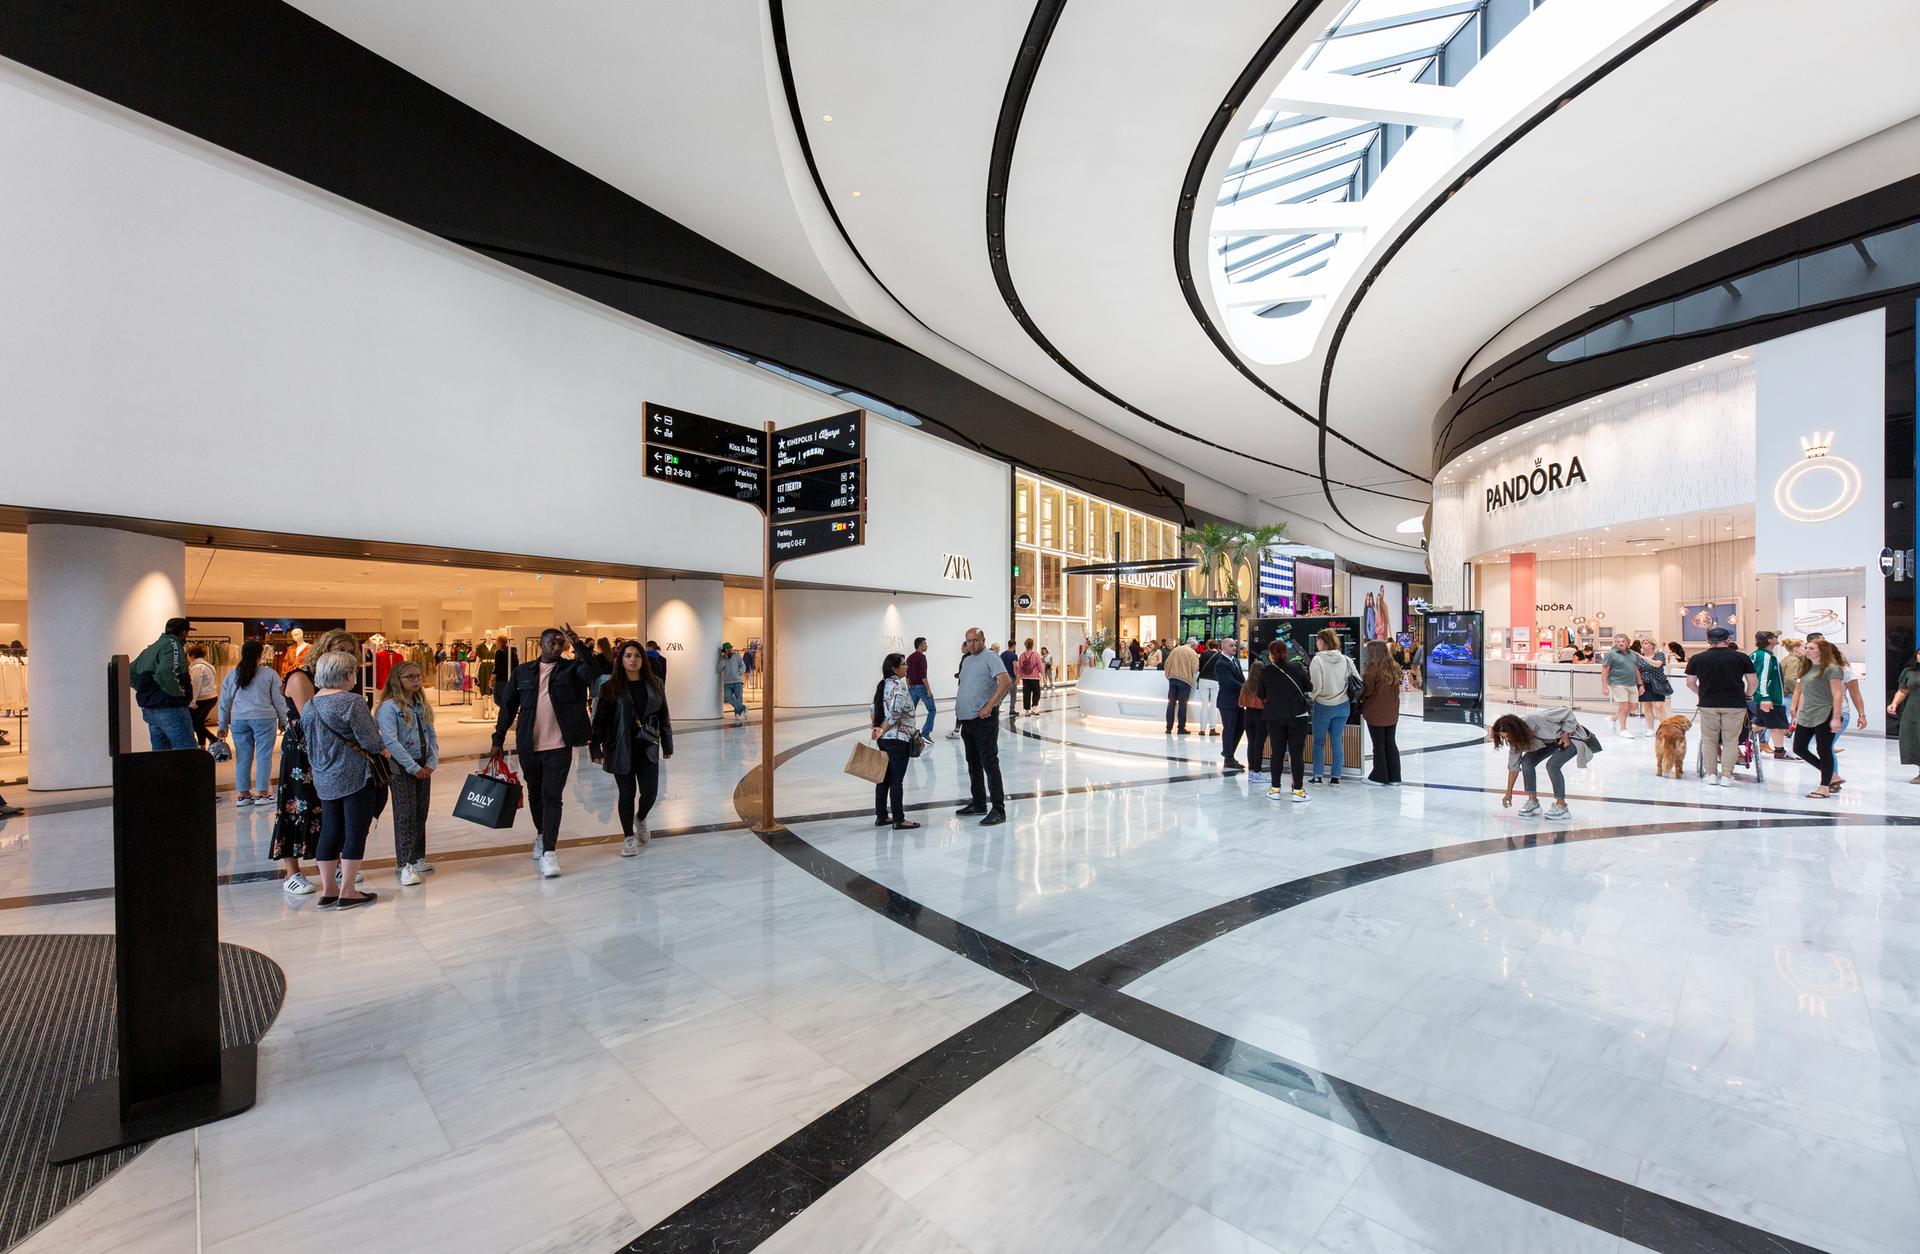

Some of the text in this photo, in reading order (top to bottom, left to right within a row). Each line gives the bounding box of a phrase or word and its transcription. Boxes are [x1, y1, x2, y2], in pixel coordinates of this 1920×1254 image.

[746, 434, 758, 444] Taxi
[786, 434, 813, 447] KINEPOLIS
[728, 442, 741, 452] Kiss
[746, 446, 758, 456] Ride
[777, 456, 797, 467] gallery
[737, 468, 758, 480] Parking
[734, 480, 753, 490] Ingang
[1486, 456, 1587, 513] PANDORA
[777, 506, 796, 514] Toiletten
[777, 529, 793, 537] Parking
[776, 542, 791, 550] Ingang
[943, 553, 973, 581] ZARA
[665, 642, 684, 651] ZARA
[467, 791, 494, 807] DAILY
